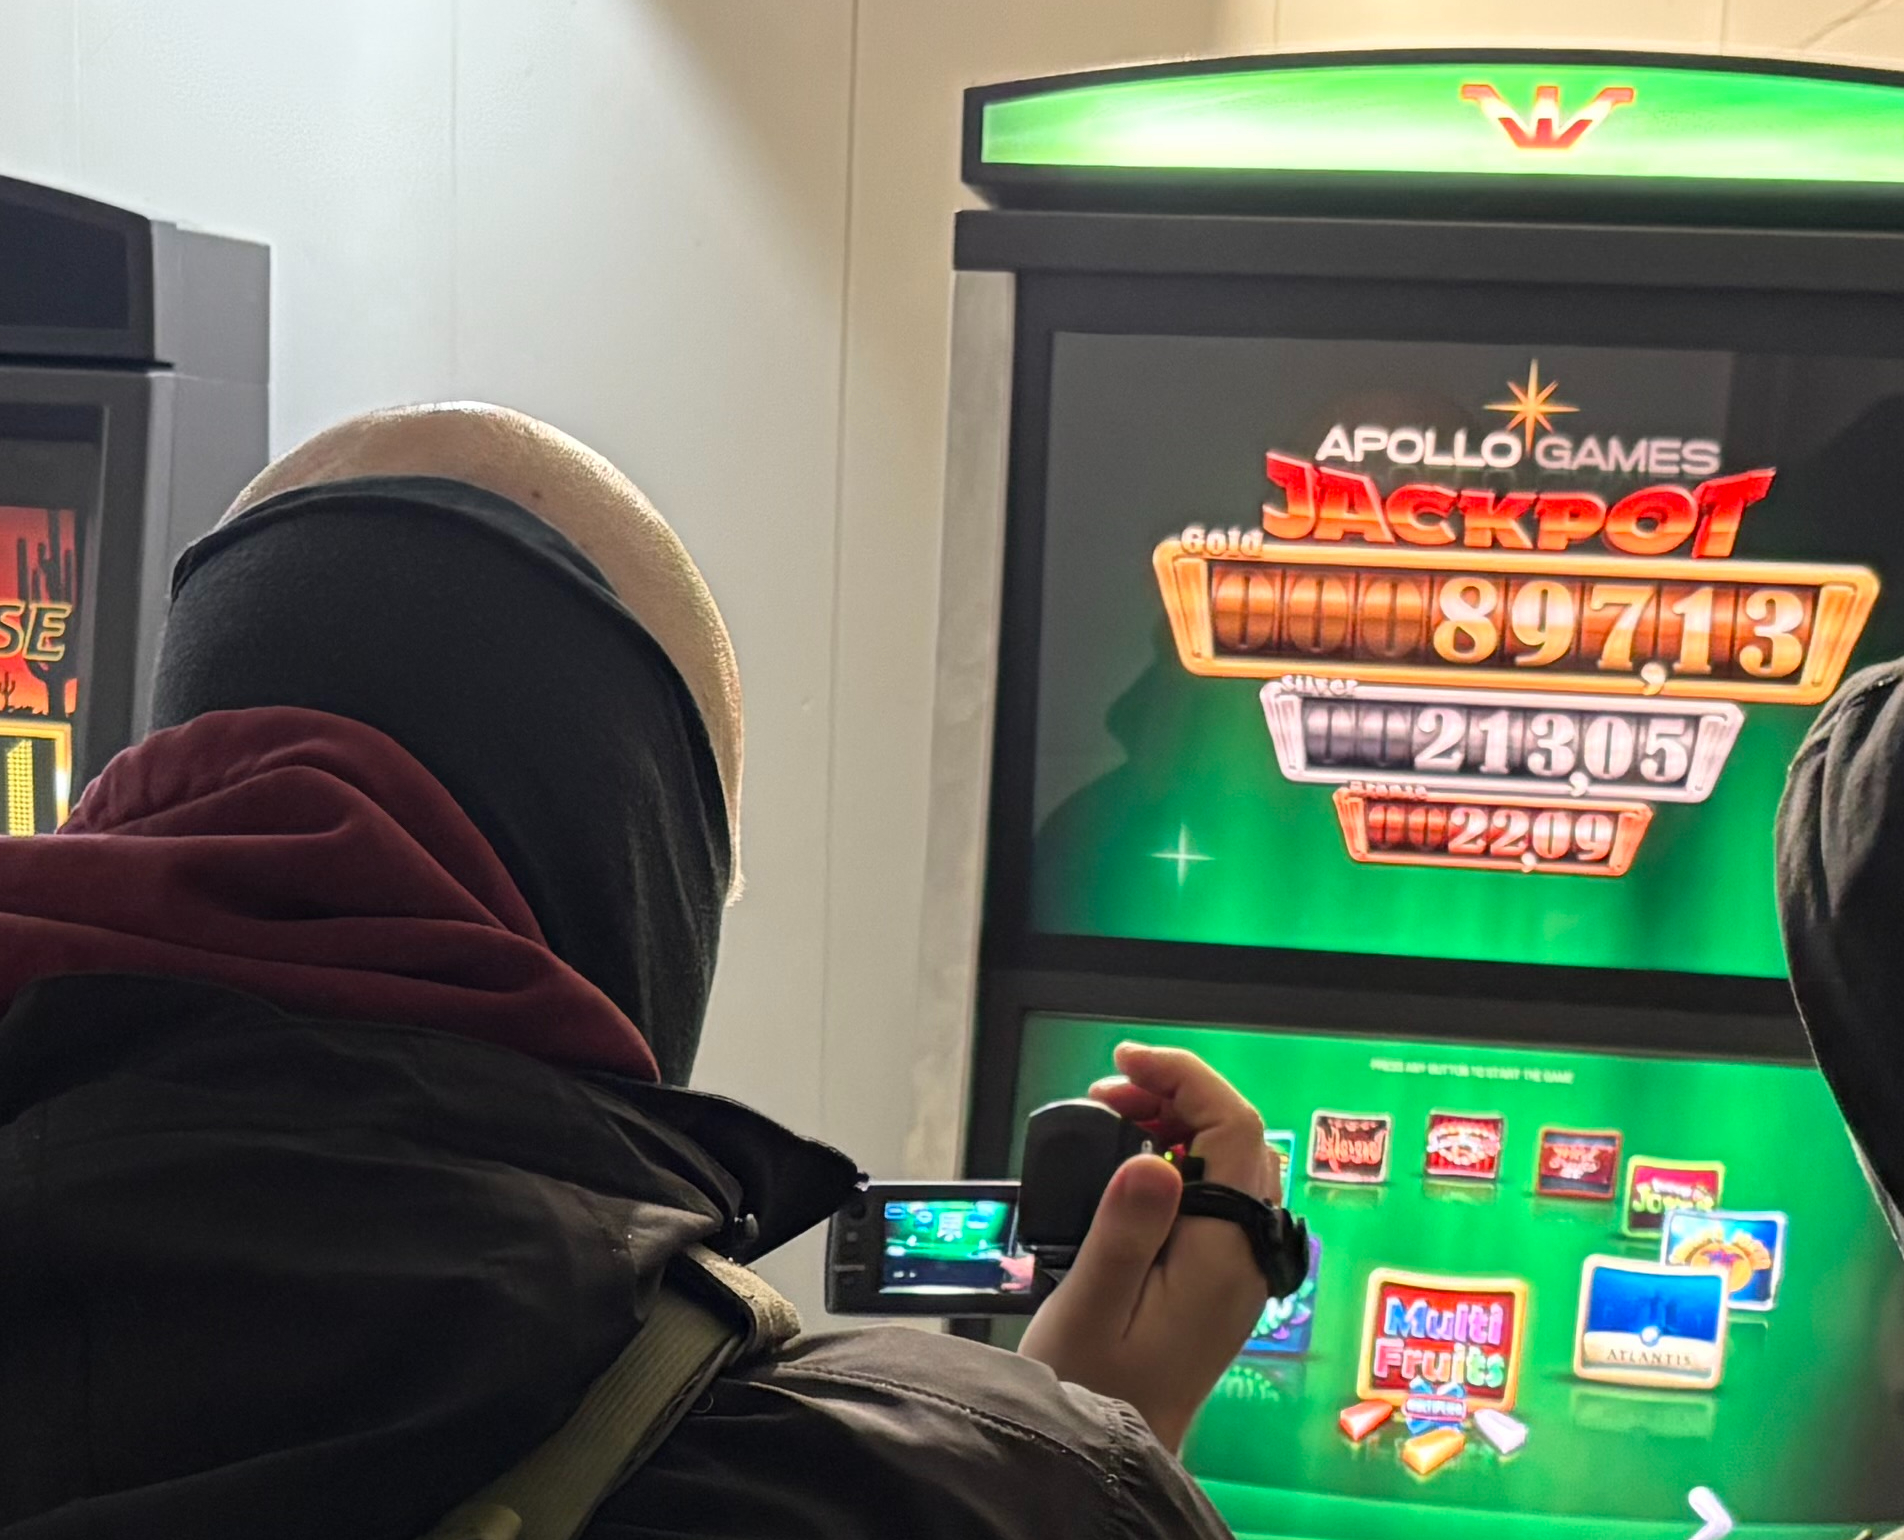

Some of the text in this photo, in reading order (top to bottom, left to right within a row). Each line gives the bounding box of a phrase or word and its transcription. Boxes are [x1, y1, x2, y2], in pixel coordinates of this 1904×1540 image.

[1315, 424, 1721, 476] APOLLO GAMES
[1261, 449, 1777, 558] JACKPOT
[1181, 524, 1264, 557] Gold
[1383, 1296, 1504, 1345] Multi
[1373, 1337, 1506, 1388] Fruits
[1607, 1348, 1693, 1367] ATLANTIS
